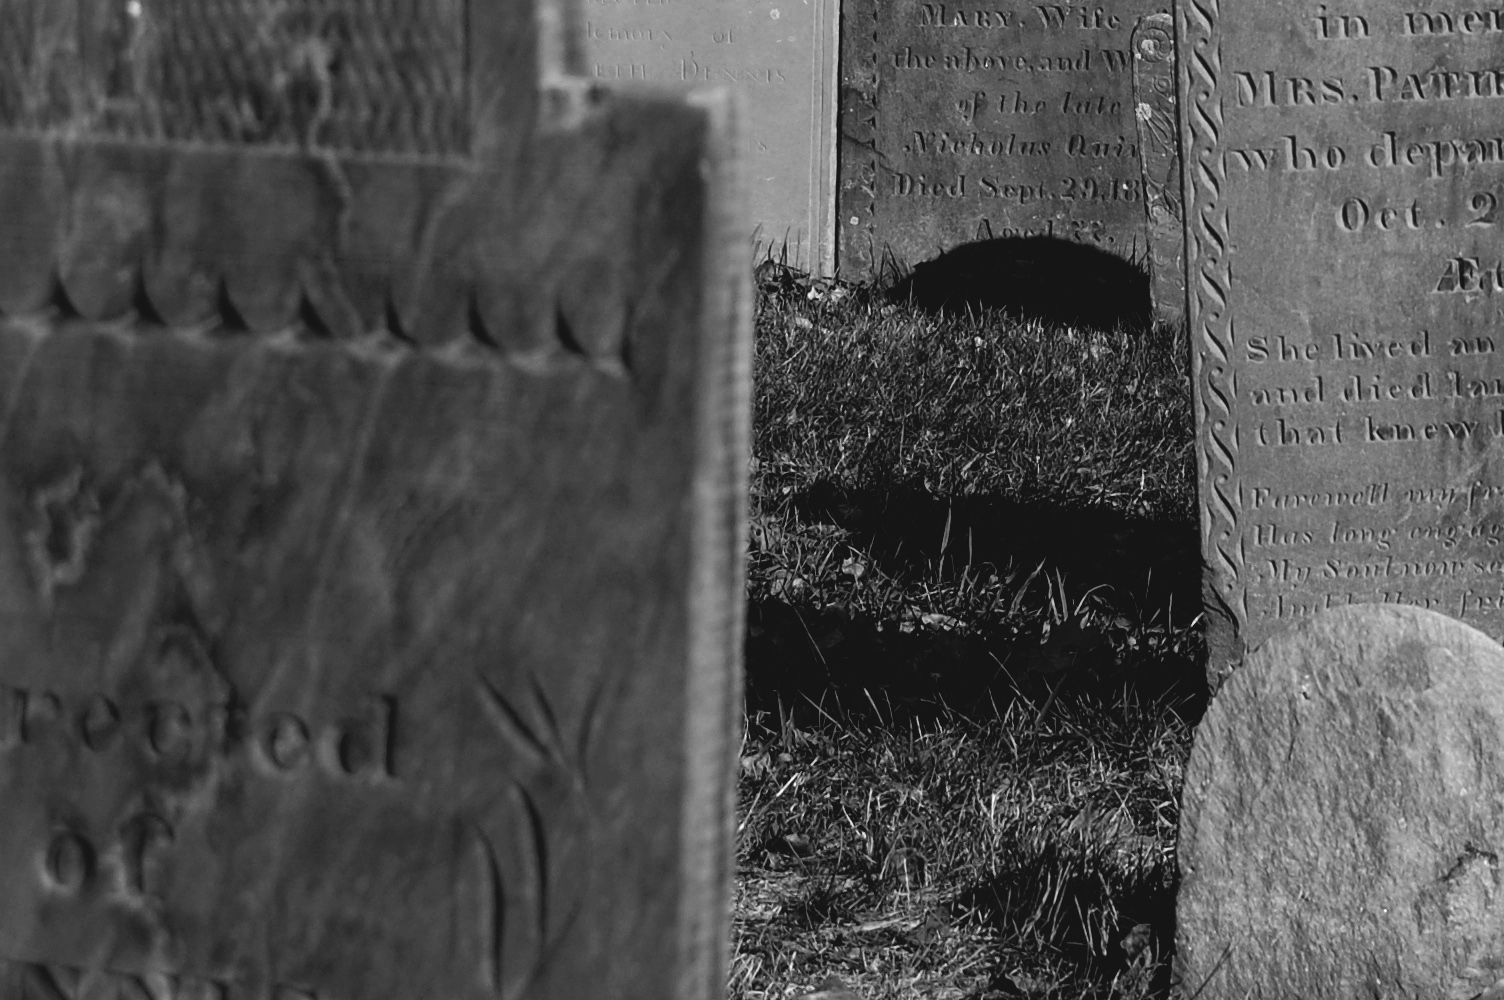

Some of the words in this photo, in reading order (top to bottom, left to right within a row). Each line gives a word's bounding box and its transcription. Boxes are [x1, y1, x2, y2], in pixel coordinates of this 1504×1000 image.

[1034, 4, 1121, 30] Wife
[1314, 4, 1370, 40] in
[893, 46, 936, 70] the
[1038, 49, 1091, 72] and
[954, 91, 986, 123] of
[999, 91, 1047, 115] the
[1062, 91, 1122, 115] late
[903, 131, 1051, 156] Nicholas
[1232, 135, 1345, 171] who
[891, 172, 966, 198] Died
[1335, 197, 1445, 231] Oct.
[1246, 335, 1320, 363] She
[1331, 330, 1431, 361] lived
[1449, 335, 1495, 356] an
[1251, 375, 1325, 405] and
[1341, 370, 1432, 402] died
[1256, 418, 1344, 446] that
[1365, 415, 1479, 442] knew
[1252, 523, 1314, 546] Has
[1330, 521, 1396, 552] long
[1323, 555, 1392, 578] Soul
